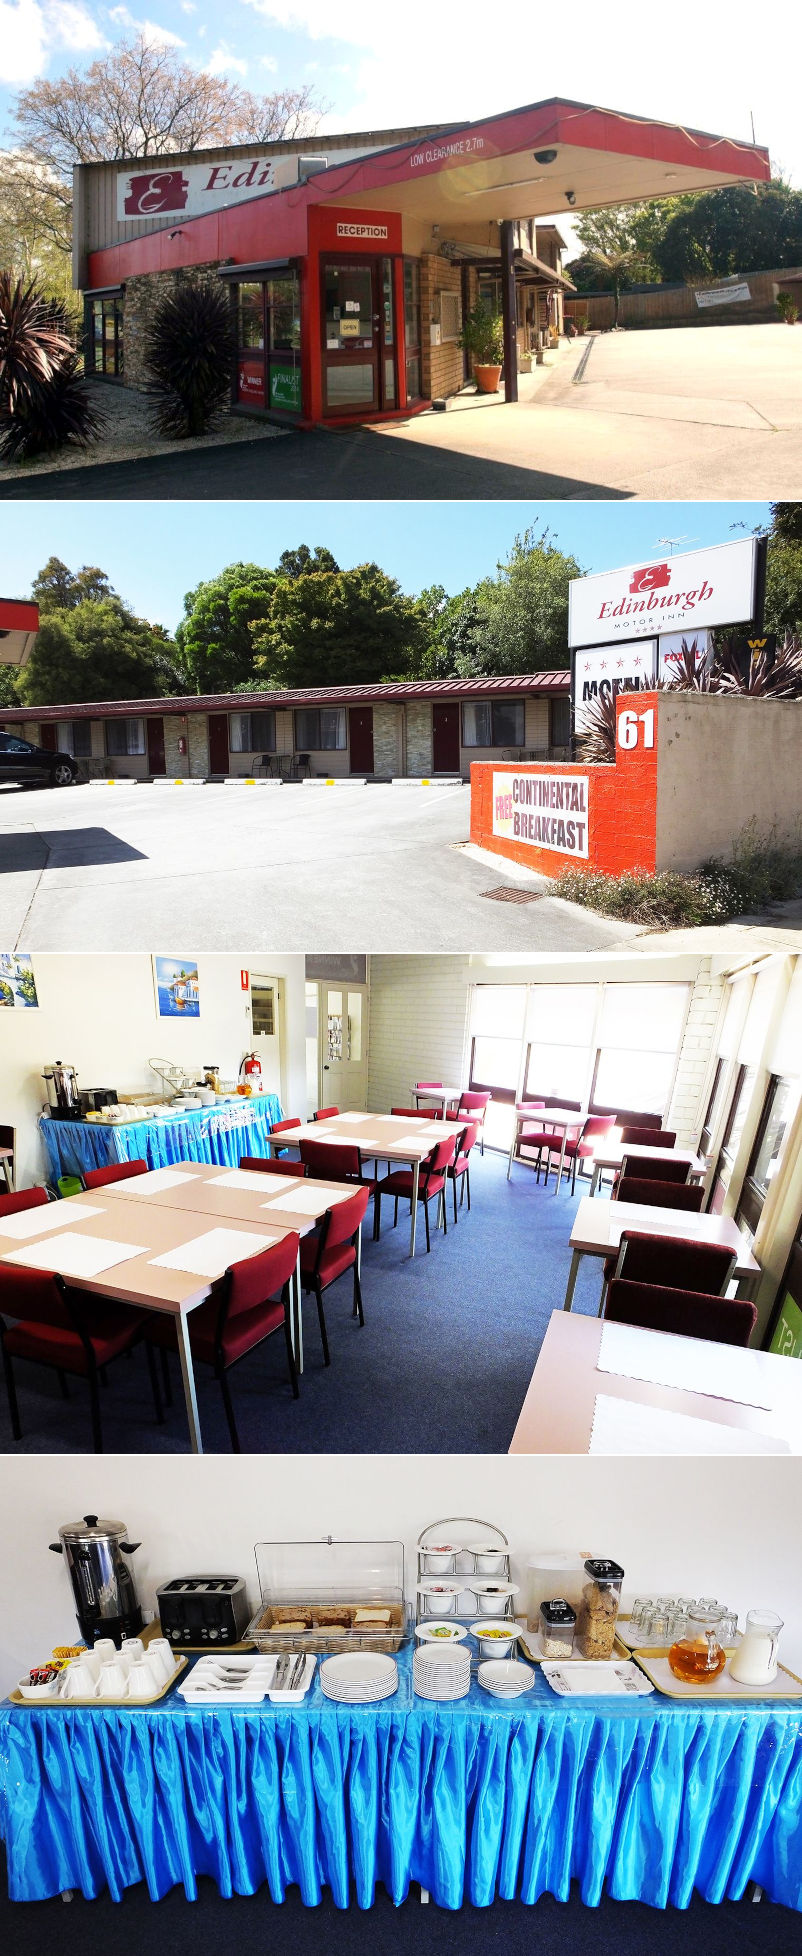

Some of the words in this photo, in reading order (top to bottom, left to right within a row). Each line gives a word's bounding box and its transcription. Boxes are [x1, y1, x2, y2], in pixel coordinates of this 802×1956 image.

[410, 153, 424, 167] LOW
[426, 141, 464, 163] CLEARANCE
[466, 137, 484, 152] 2.7m
[203, 160, 275, 191] Edi
[338, 224, 387, 238] RECEPTION
[596, 580, 715, 620] Edinburgh
[614, 617, 654, 630] MOTOR
[662, 612, 685, 622] INN
[664, 650, 701, 663] FOXL
[618, 708, 655, 750] 61
[495, 793, 513, 820] FREE
[512, 778, 587, 812] CONTINENTAL
[513, 811, 586, 852] BREAKFAST
